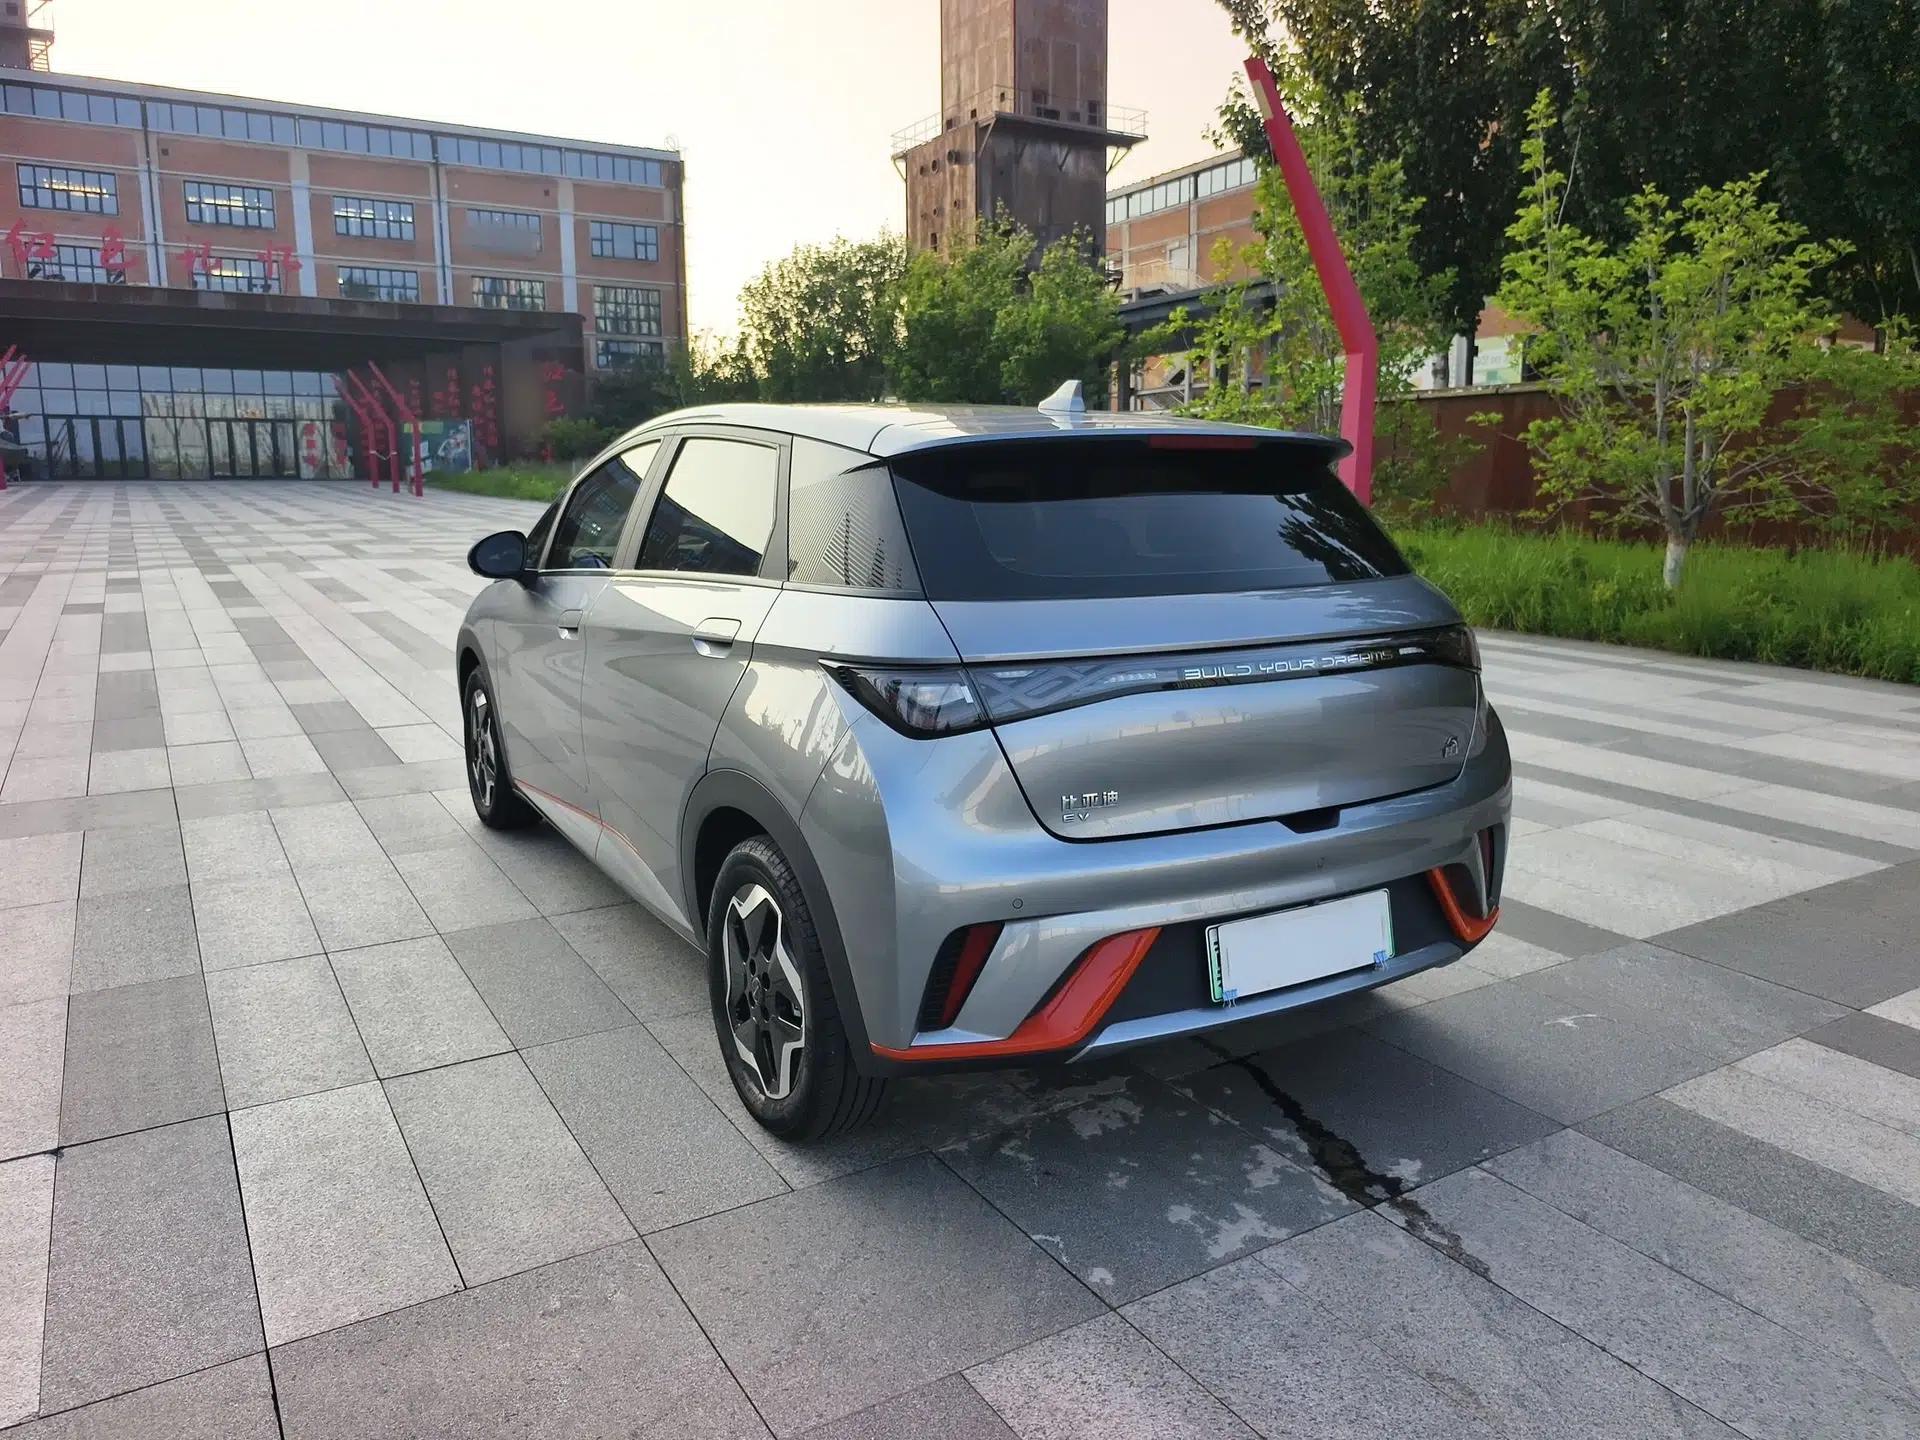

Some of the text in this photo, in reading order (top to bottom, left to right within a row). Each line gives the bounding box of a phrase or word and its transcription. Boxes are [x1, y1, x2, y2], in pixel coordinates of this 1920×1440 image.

[1184, 650, 1393, 680] BUILD YOUR DREAMS
[1062, 791, 1119, 811] 比亚迪
[1063, 813, 1090, 823] EV
